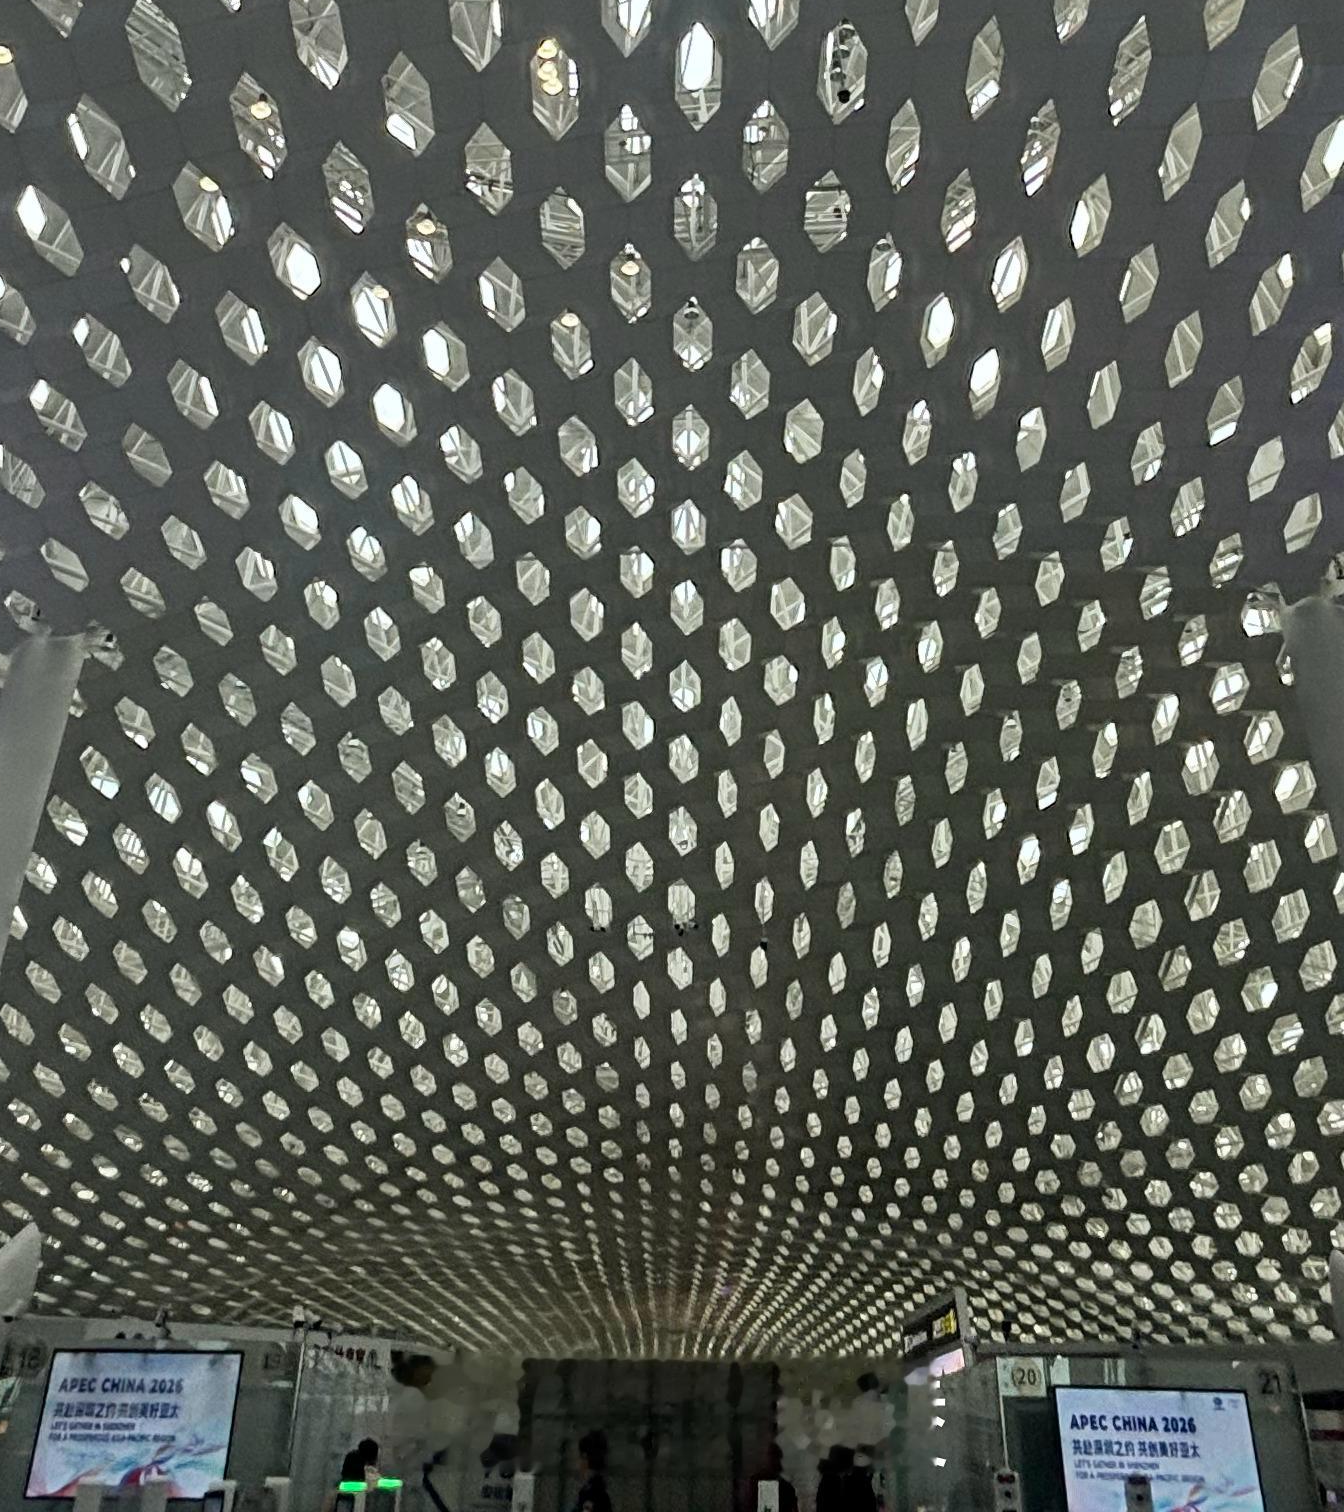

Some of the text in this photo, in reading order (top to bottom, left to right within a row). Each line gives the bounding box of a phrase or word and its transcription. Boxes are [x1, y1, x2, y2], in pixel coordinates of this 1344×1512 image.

[58, 1377, 184, 1394] APEC CHINA 2026
[1015, 1367, 1038, 1386] 20
[1257, 1368, 1282, 1395] 21
[1070, 1414, 1198, 1434] APEC CHINA 2026
